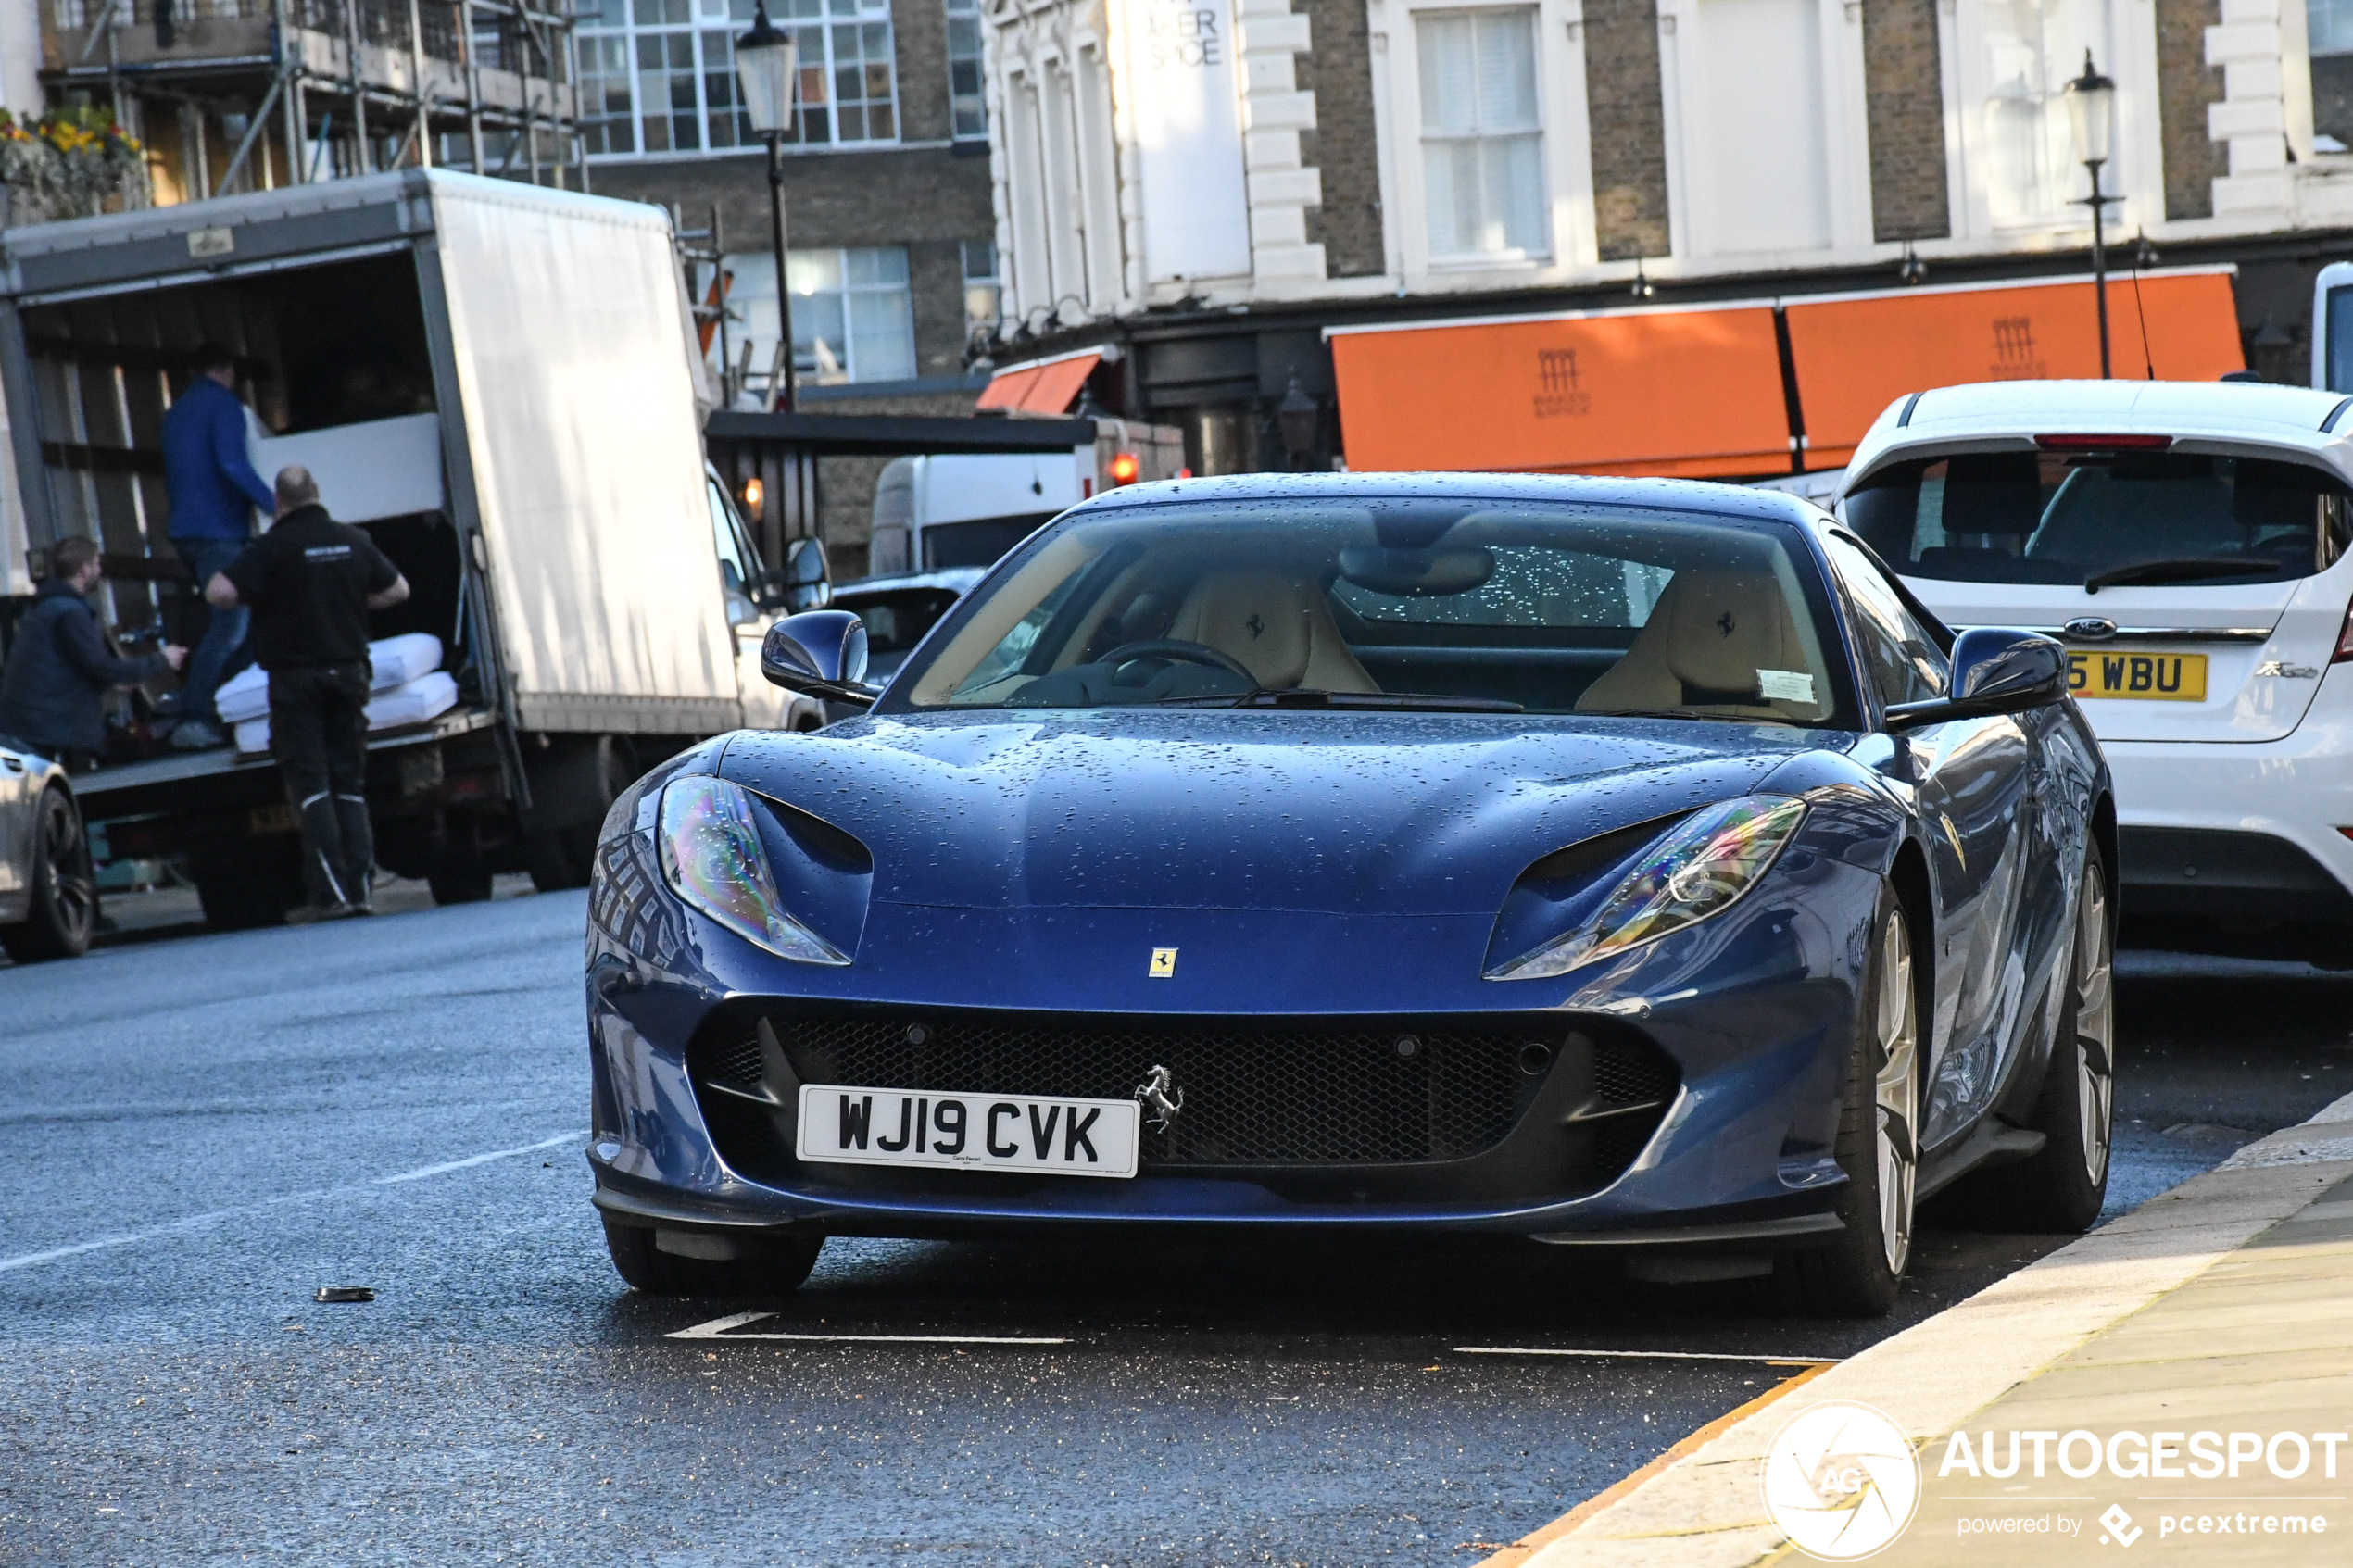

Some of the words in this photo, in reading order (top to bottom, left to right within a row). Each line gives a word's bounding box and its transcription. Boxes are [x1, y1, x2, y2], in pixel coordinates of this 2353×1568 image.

[2102, 656, 2182, 693] WBU
[839, 1094, 967, 1156] WJ19
[986, 1102, 1101, 1163] CVK
